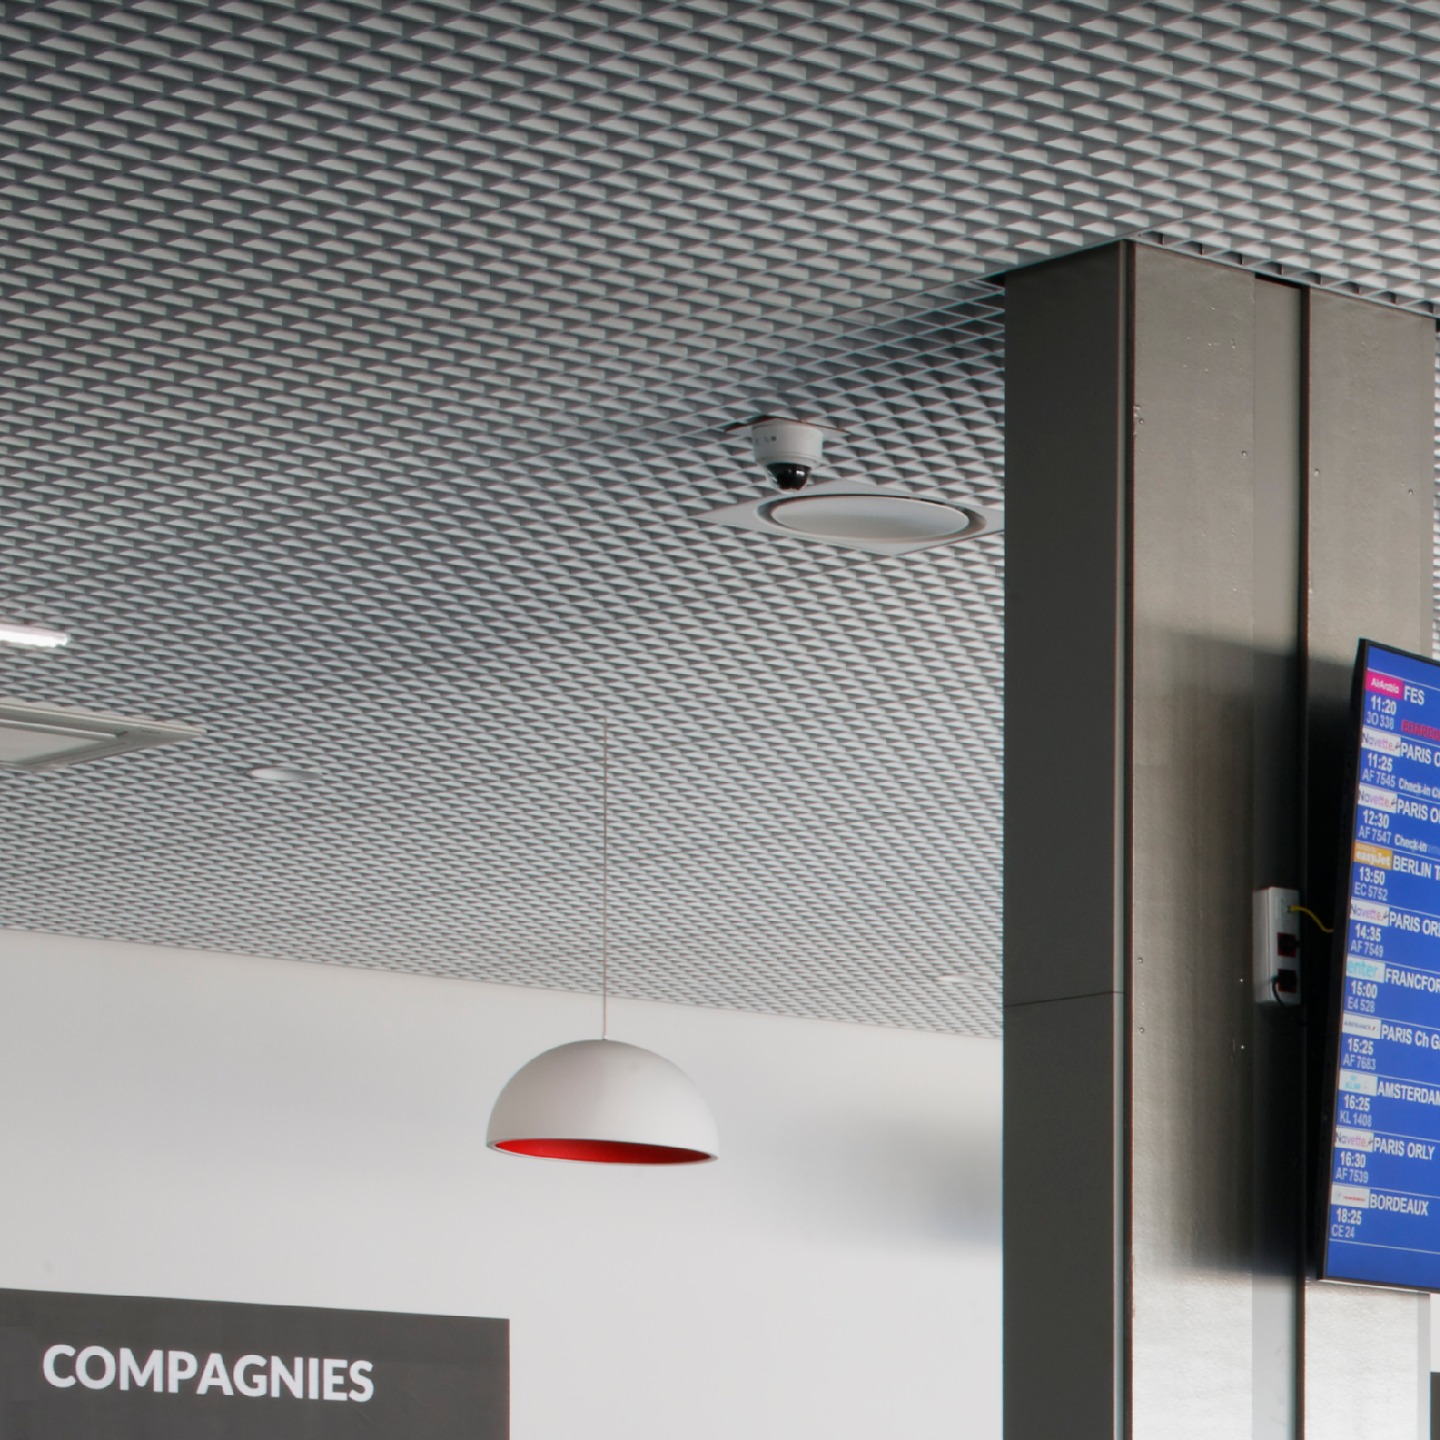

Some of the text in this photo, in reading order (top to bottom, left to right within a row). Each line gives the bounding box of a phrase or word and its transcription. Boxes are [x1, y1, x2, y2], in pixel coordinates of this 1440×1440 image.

[1404, 686, 1425, 705] FES
[1371, 696, 1397, 714] 11:20
[1380, 714, 1394, 730] 338
[1367, 753, 1393, 772] 11:25
[1401, 743, 1432, 764] PARIS
[1362, 769, 1395, 788] AF 7545
[1399, 778, 1431, 796] Check-in
[1363, 809, 1389, 829] 12:30
[1397, 799, 1428, 821] PARIS
[1358, 825, 1391, 844] AF 7547
[1394, 834, 1427, 852] Check-in
[1359, 867, 1385, 885] 13:50
[1393, 855, 1431, 879] BERLIN
[1355, 882, 1388, 901] EC 5752
[1389, 912, 1420, 932] PARIS
[1355, 924, 1381, 942] 14:35
[1351, 940, 1364, 952] AF
[1351, 980, 1377, 998] 15:00
[1348, 997, 1359, 1011] E4
[1382, 1024, 1412, 1045] PARIS
[1415, 1031, 1428, 1047] Ch
[1348, 1037, 1374, 1055] 15:25
[1343, 1054, 1355, 1066] AF
[1344, 1095, 1370, 1111] 16:25
[1340, 1111, 1351, 1123] KL
[1374, 1138, 1435, 1160] PARIS ORLY
[1340, 1151, 1366, 1168] 16:30
[1336, 1168, 1348, 1180] AF
[1370, 1194, 1429, 1216] BORDEAUX
[1337, 1208, 1361, 1225] 18:25
[1332, 1224, 1355, 1238] CE 24
[43, 1345, 374, 1402] COMPAGNIES
